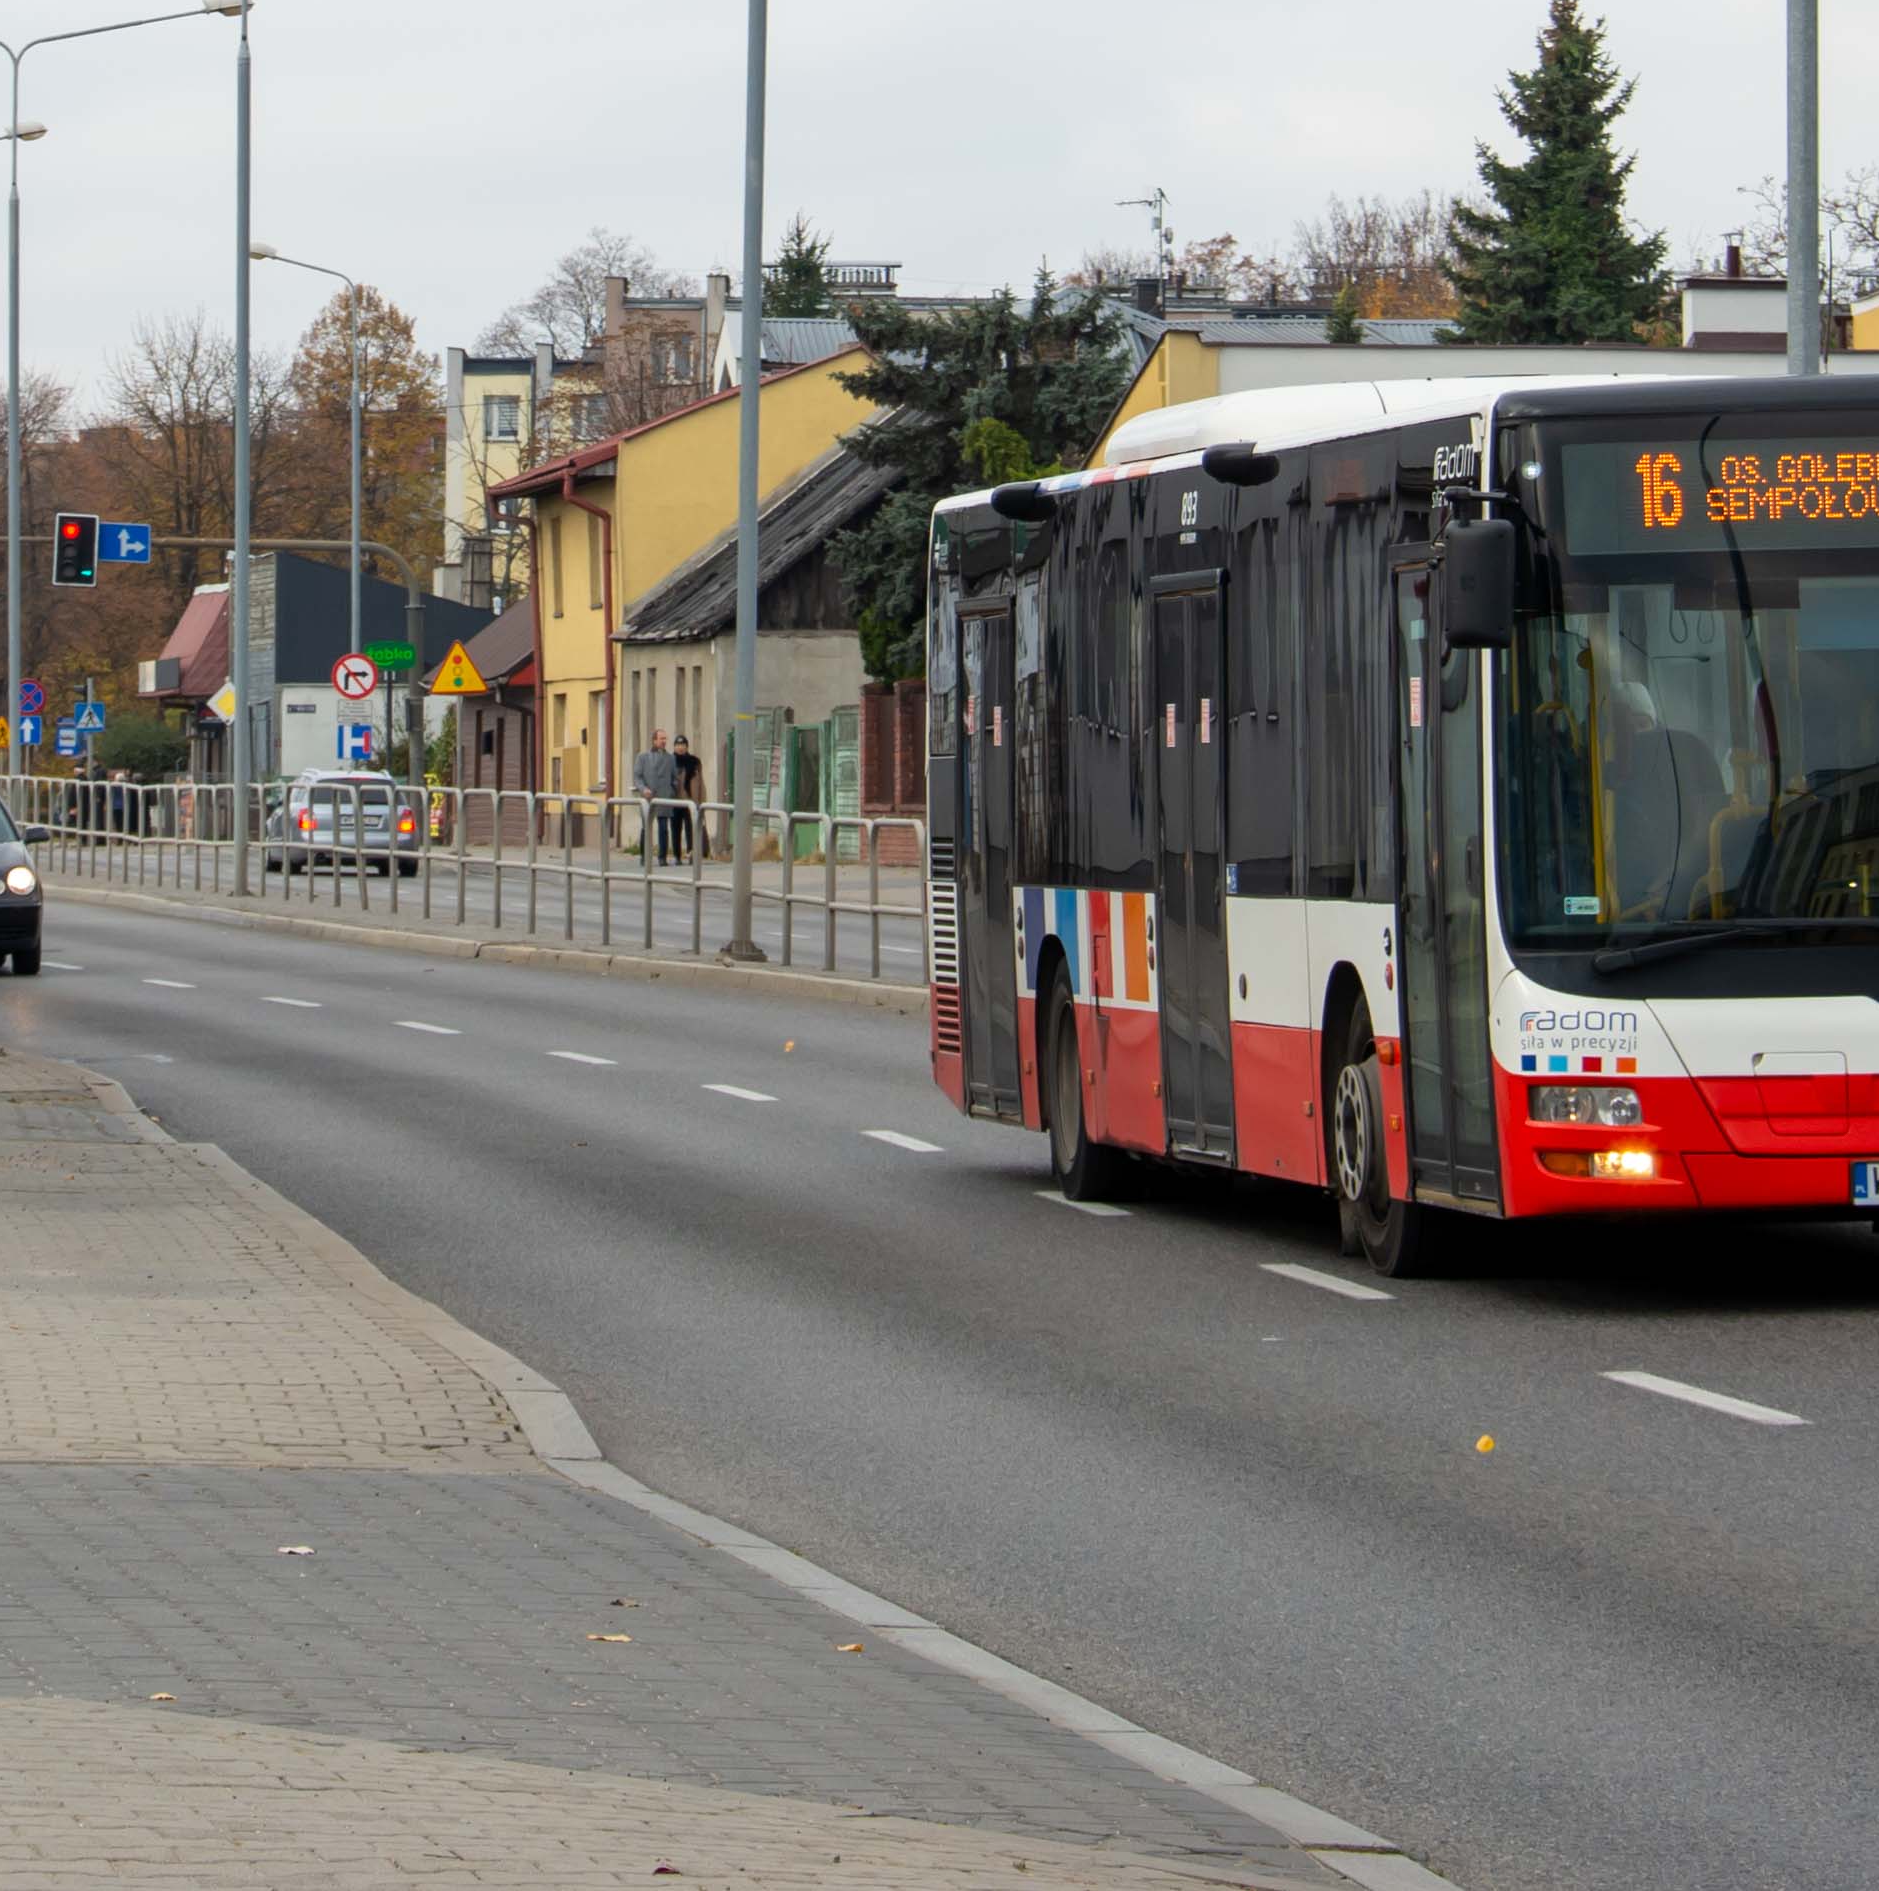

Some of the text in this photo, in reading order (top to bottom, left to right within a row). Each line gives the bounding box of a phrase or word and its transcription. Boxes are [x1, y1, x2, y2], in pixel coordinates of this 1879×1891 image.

[1722, 456, 1768, 485] OS.
[1635, 453, 1682, 528] 16
[1181, 490, 1198, 526] 893
[1520, 1010, 1637, 1032] radom
[1521, 1036, 1638, 1053] siła w precyzji
